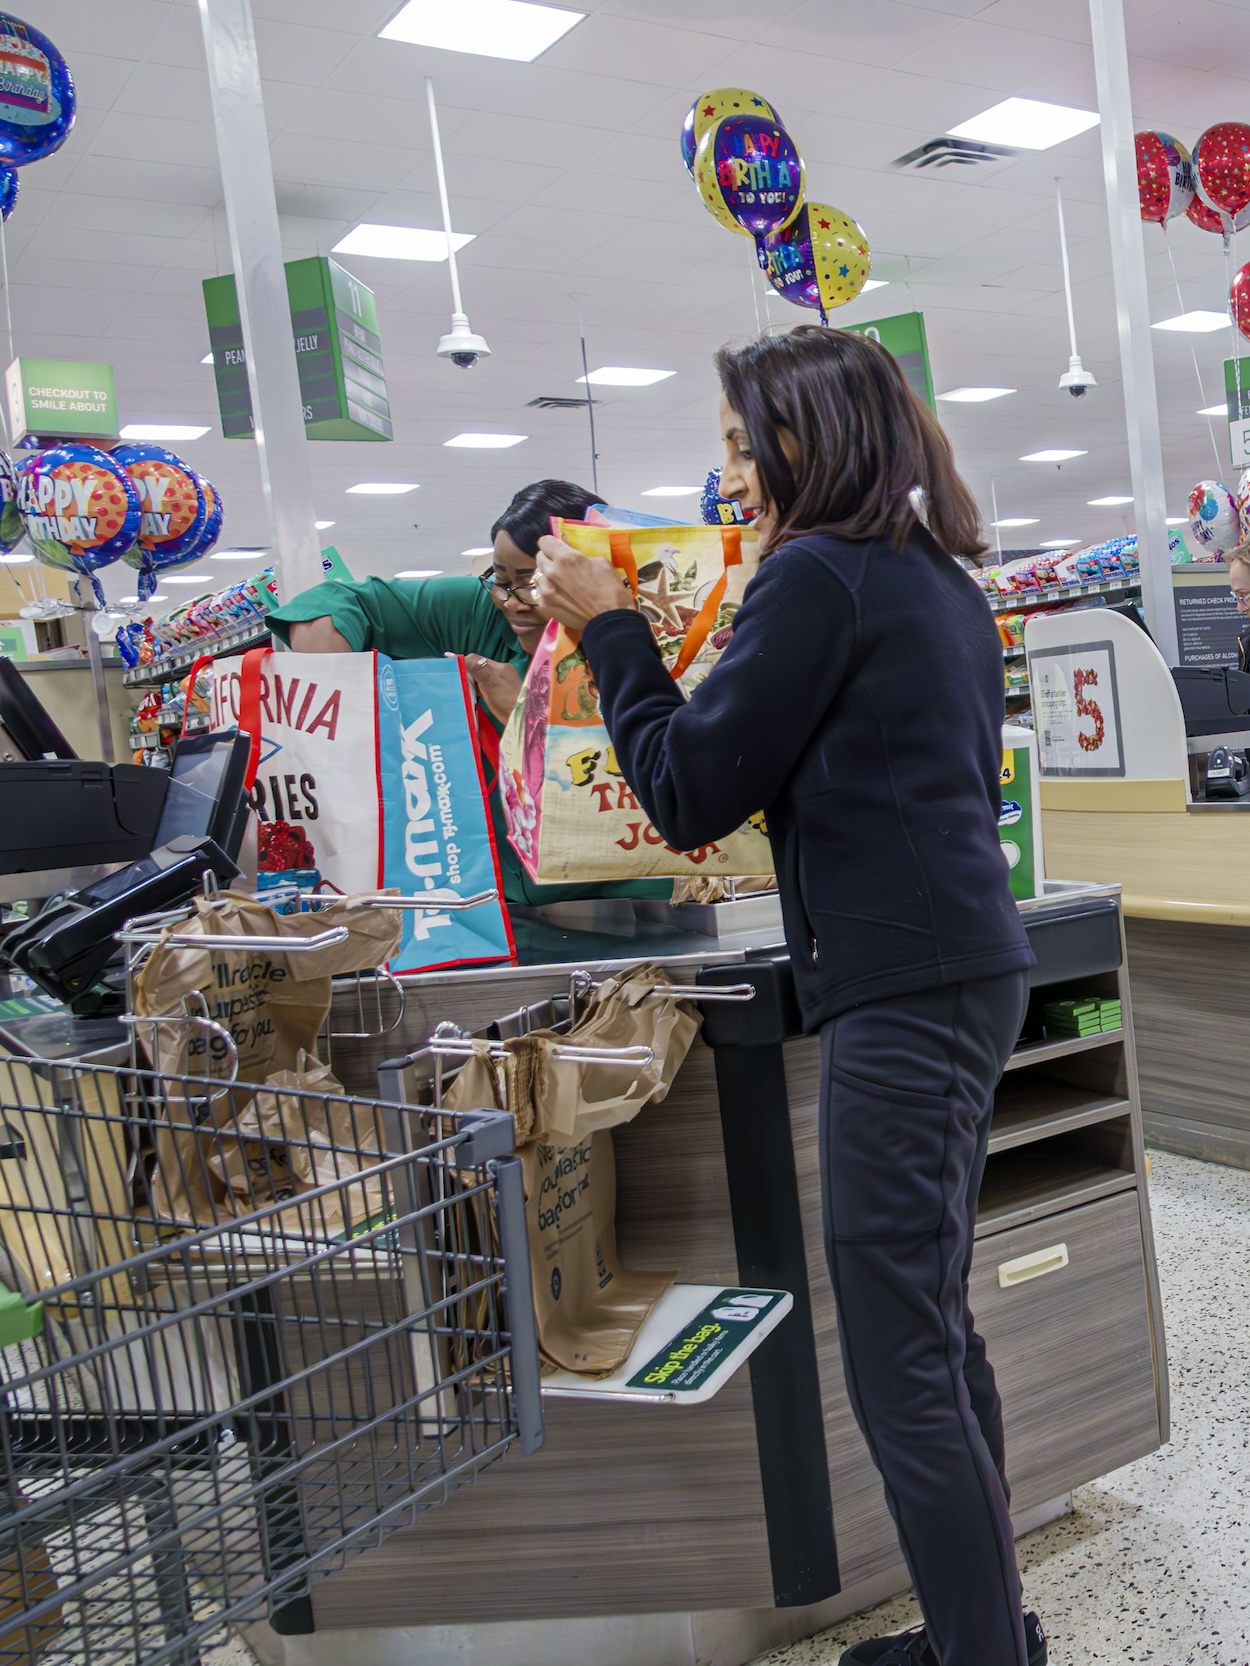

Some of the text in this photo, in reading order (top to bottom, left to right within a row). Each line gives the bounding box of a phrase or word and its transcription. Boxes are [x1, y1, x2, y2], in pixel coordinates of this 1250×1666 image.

[295, 335, 318, 353] JELLY
[28, 387, 108, 401] CHECKOUT TO
[31, 399, 107, 412] SMILE ABOUT
[1179, 597, 1207, 606] RETURNED
[1207, 596, 1223, 604] CHECK
[1184, 653, 1214, 662] PURCHASES
[1222, 652, 1239, 660] ALCOH
[445, 842, 462, 885] shop
[643, 1323, 722, 1384] Skip the bag.
